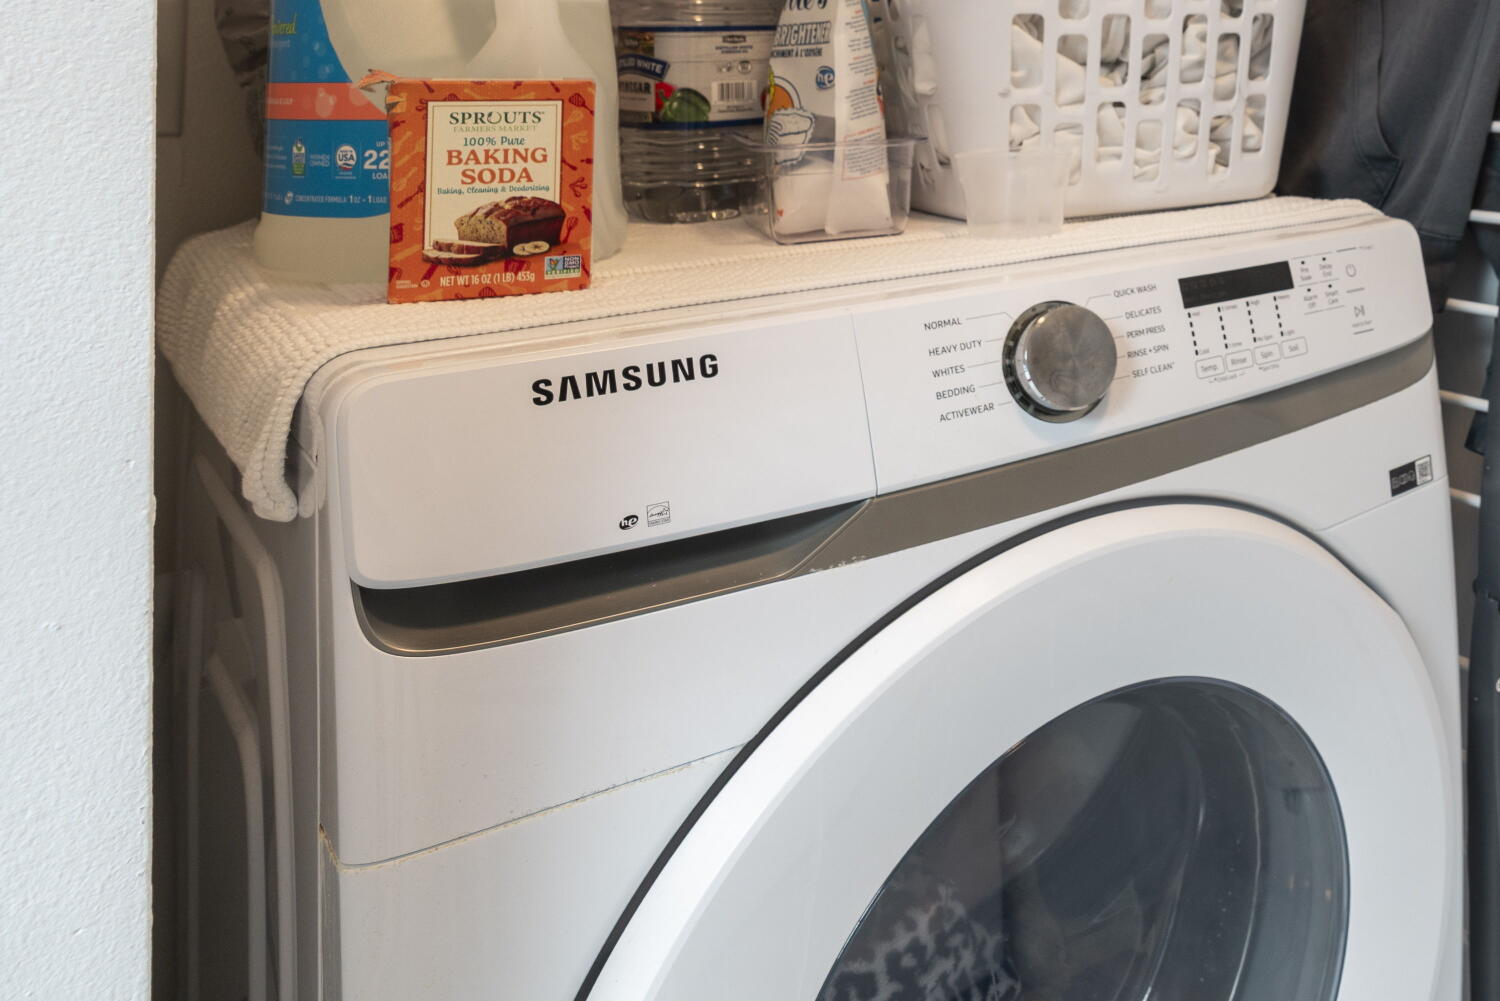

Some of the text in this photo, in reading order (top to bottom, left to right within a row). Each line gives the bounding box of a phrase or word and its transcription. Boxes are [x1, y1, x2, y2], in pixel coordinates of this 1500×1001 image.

[449, 110, 542, 125] SPROUTS
[453, 124, 537, 133] FARMERS MARKET
[464, 135, 526, 147] 100% Pure
[338, 153, 355, 162] USA
[446, 147, 548, 167] BAKING
[461, 167, 533, 185] SODA
[437, 187, 464, 196] Baking,
[466, 186, 498, 195] Cleaning
[509, 185, 550, 193] Deodorizing
[440, 271, 535, 287] NET WT 16 OZ (1 LB) 453g
[1113, 284, 1157, 298] QUICK WASH
[1125, 305, 1162, 319] DELICATES
[924, 317, 962, 331] NORMAL
[1126, 325, 1166, 339] PERM PRESS
[928, 339, 982, 357] HEAVY DUTY
[1127, 348, 1148, 359] RINSE
[1153, 344, 1169, 355] SPIN
[932, 365, 965, 378] WHITES
[1132, 369, 1148, 379] SELF
[531, 353, 719, 406] SAMSUNG
[936, 385, 976, 400] BEDDING
[939, 403, 995, 422] ACTIVEWEAR
[619, 515, 639, 530] he
